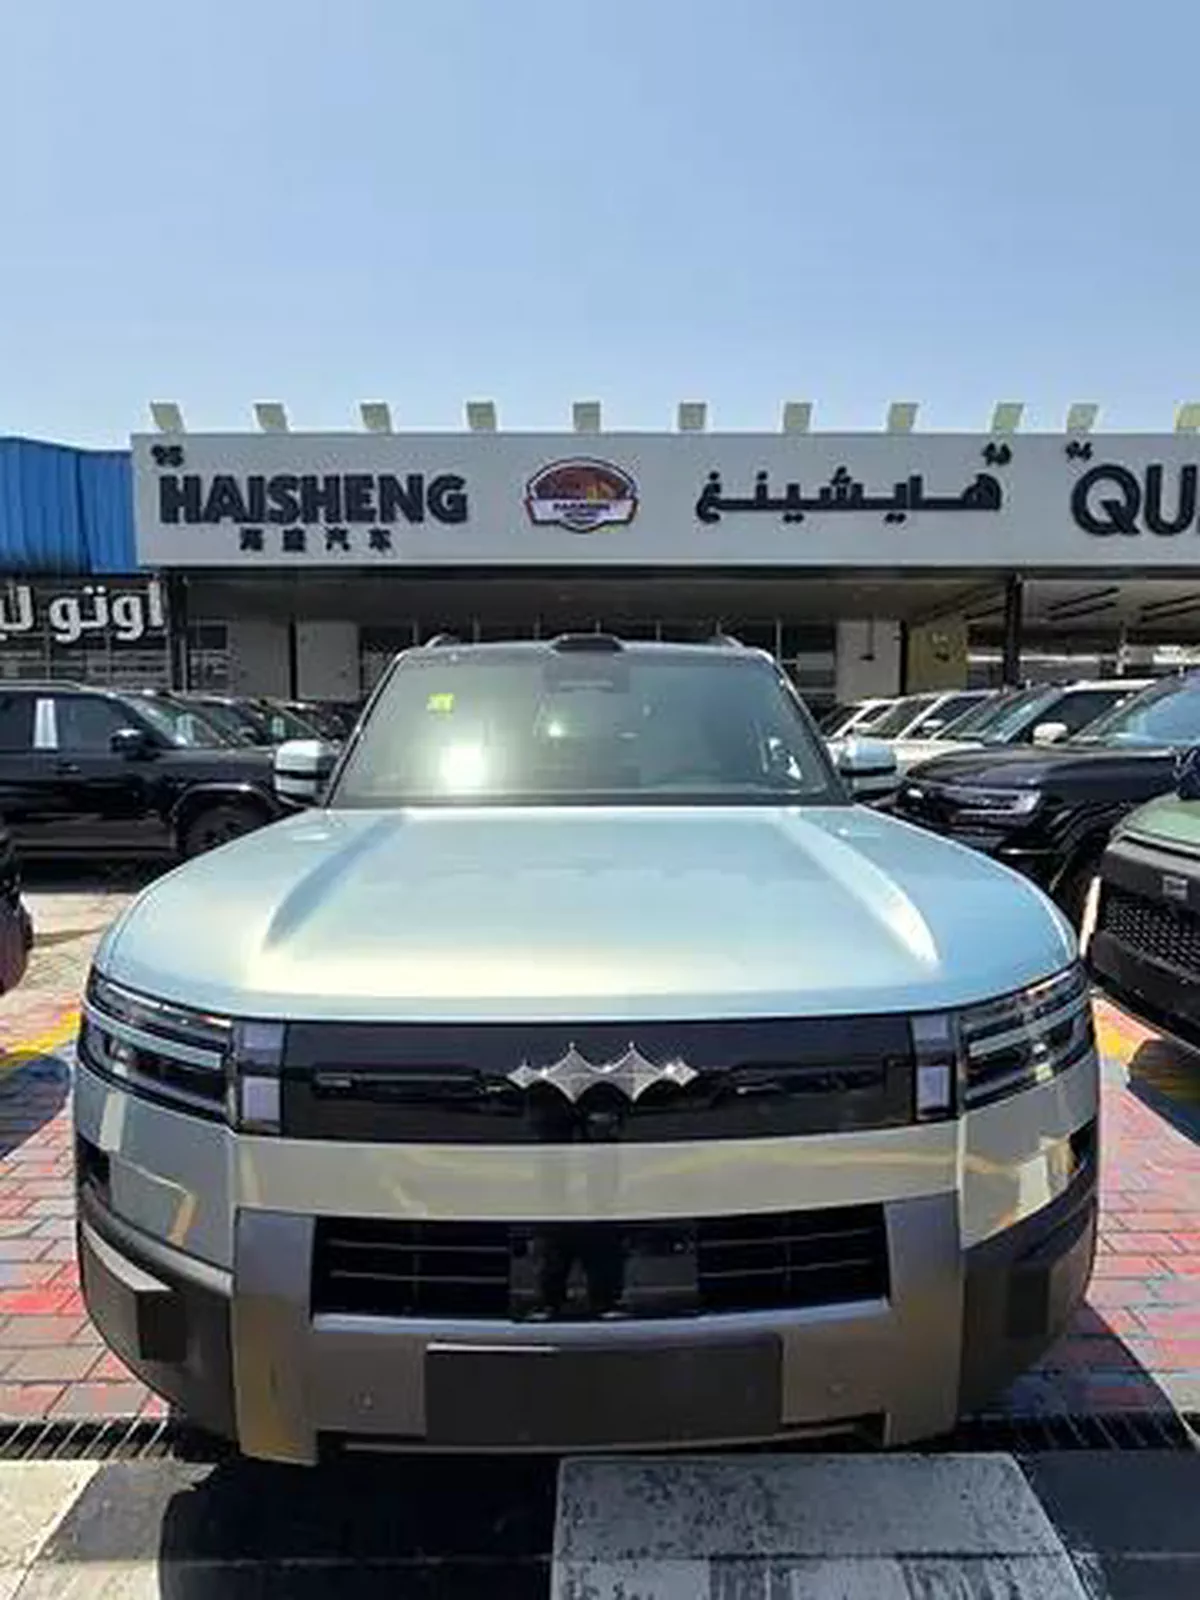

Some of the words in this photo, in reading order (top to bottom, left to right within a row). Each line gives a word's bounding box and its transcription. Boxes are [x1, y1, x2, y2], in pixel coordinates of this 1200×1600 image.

[159, 474, 467, 524] HAISHENG
[1070, 464, 1200, 537] QU
[51, 580, 164, 643] اوتو
